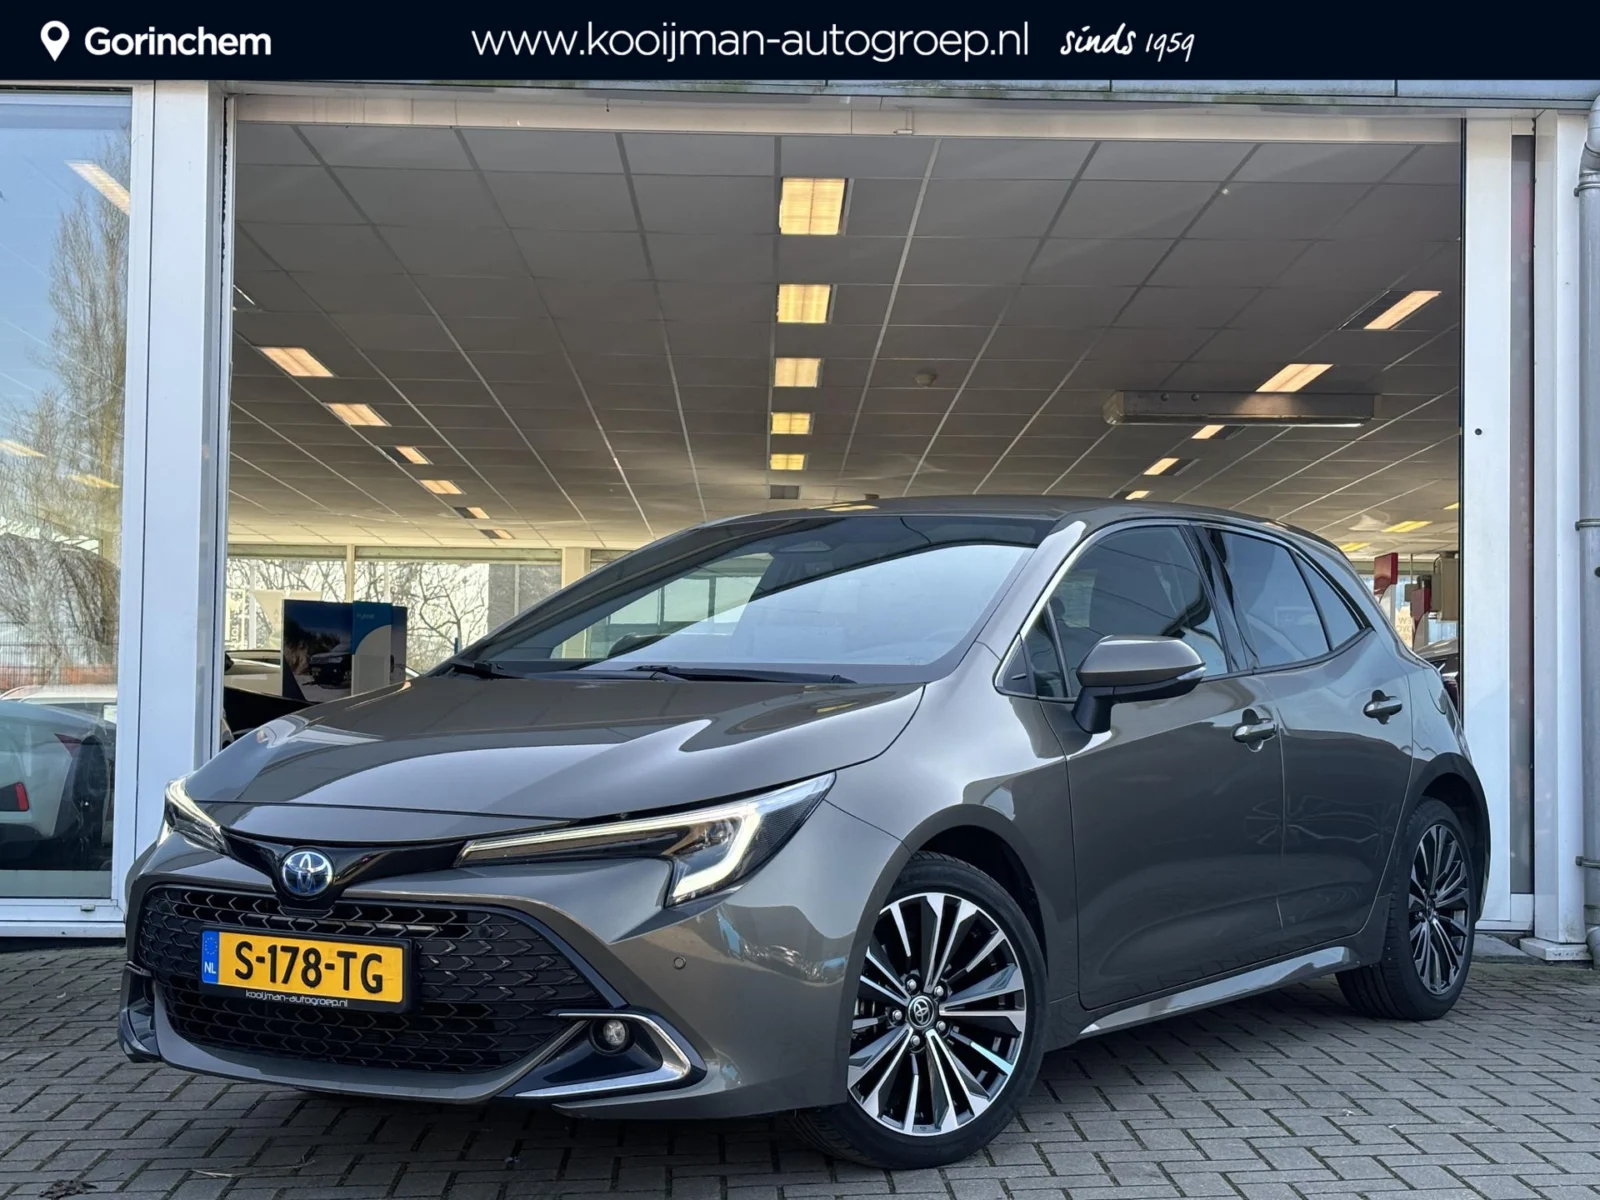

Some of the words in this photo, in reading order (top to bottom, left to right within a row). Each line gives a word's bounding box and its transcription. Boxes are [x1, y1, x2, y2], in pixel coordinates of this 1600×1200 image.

[204, 961, 217, 975] NL
[234, 940, 384, 995] S-178-TG
[245, 989, 349, 1008] kooijman-autogroep.nl
